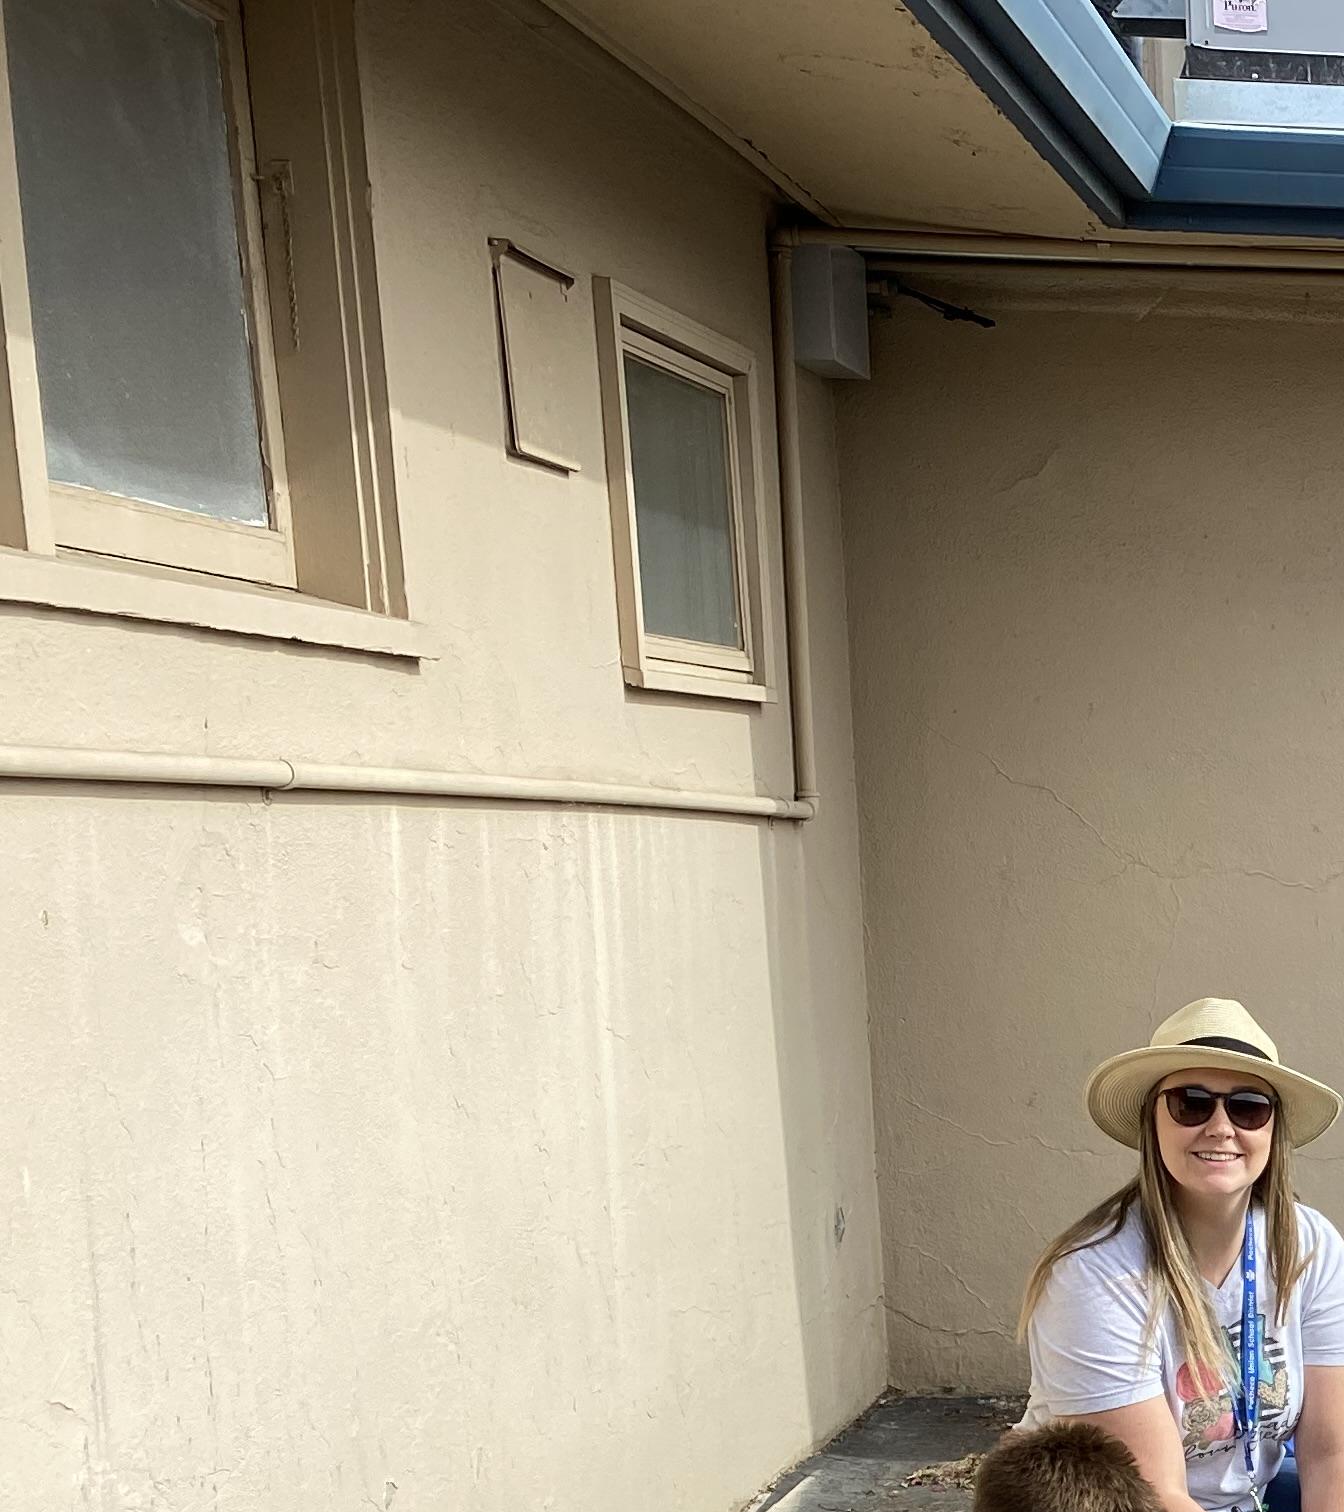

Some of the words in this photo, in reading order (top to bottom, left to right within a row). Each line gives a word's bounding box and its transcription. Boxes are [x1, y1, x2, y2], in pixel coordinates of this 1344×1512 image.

[1247, 1291, 1255, 1319] District
[1247, 1320, 1255, 1348] School
[1247, 1350, 1255, 1374] Union
[1248, 1376, 1256, 1410] Pacheco
